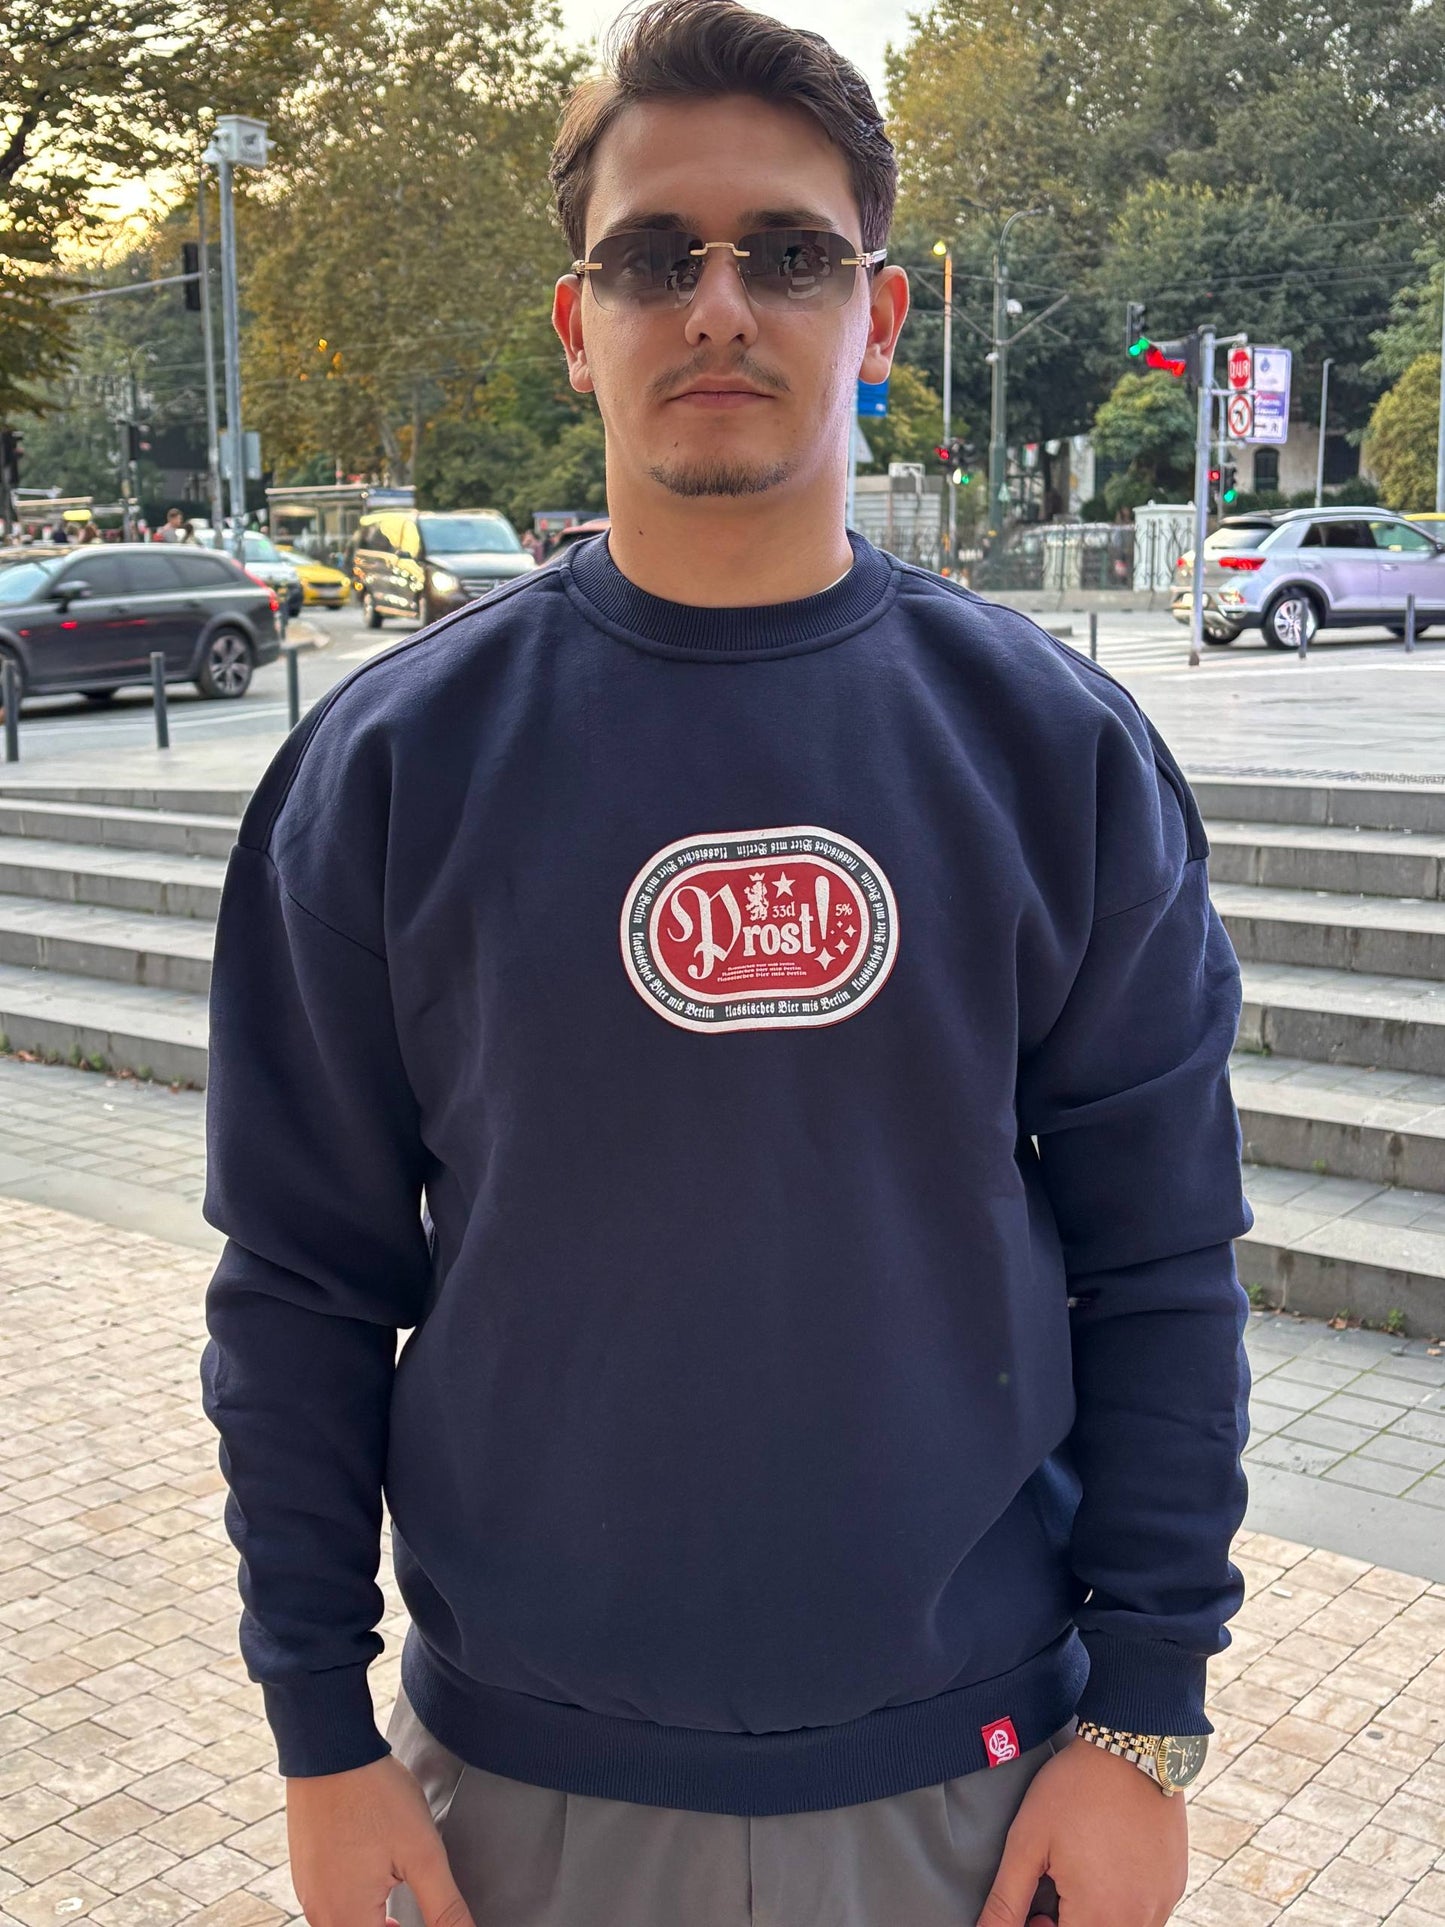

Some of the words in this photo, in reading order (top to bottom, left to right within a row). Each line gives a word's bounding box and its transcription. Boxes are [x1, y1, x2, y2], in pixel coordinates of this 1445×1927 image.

[1229, 361, 1250, 378] DUR
[737, 843, 767, 857] Berlin
[860, 871, 881, 902] Berlin
[632, 893, 652, 924] Berlin
[772, 901, 796, 918] 33cl
[835, 903, 853, 916] 5%
[820, 991, 851, 1011] Berlin
[684, 1002, 714, 1018] Berlin
